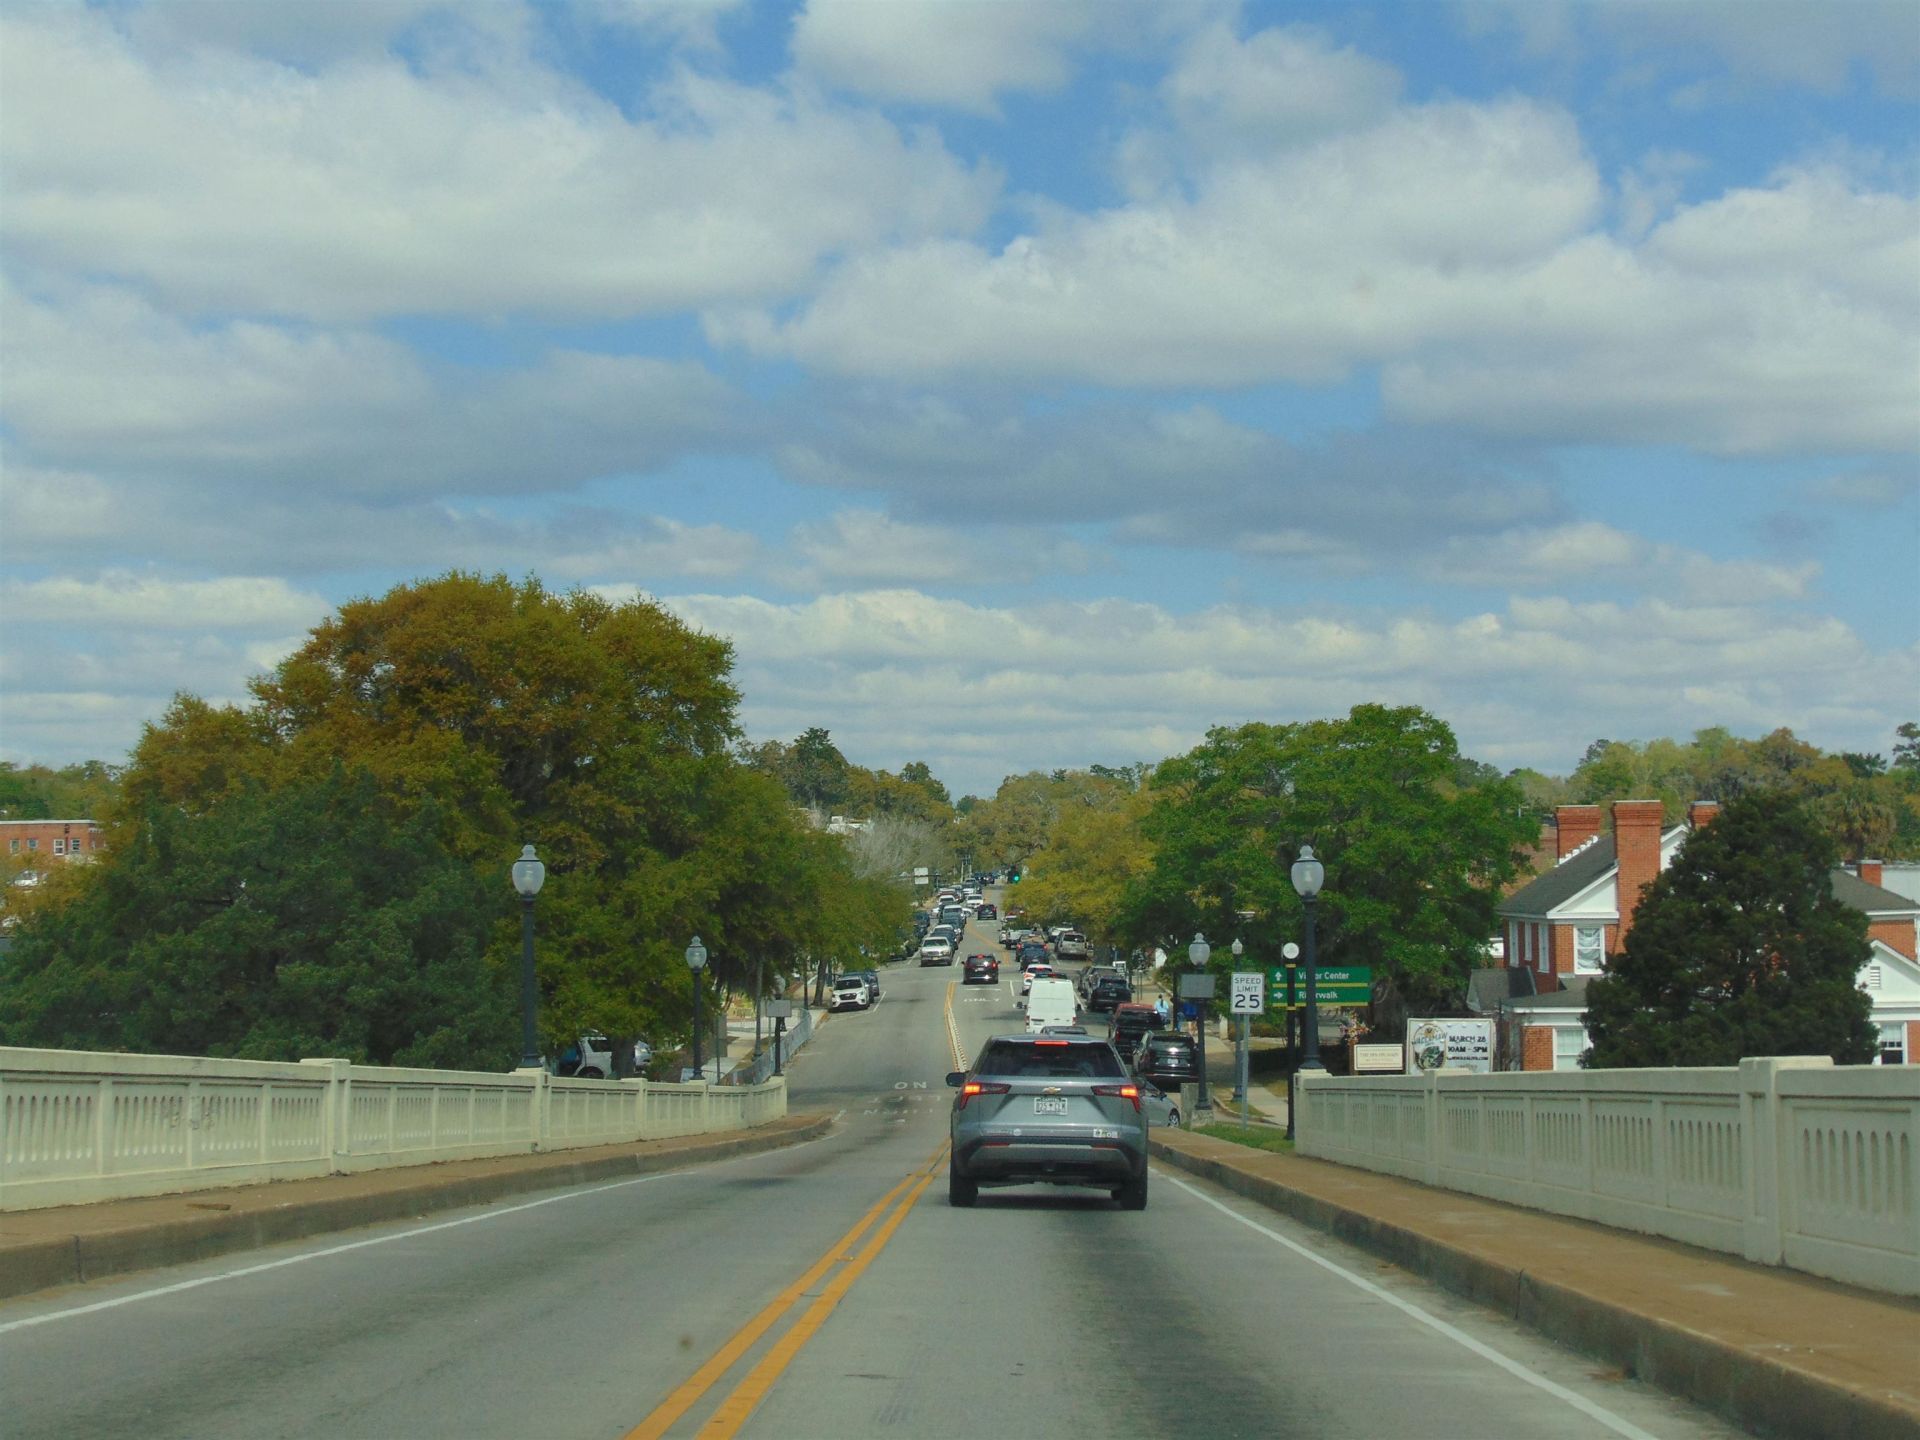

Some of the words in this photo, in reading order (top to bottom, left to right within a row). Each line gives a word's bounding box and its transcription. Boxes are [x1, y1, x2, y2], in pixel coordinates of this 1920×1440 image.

[1298, 971, 1322, 979] Vior
[1324, 971, 1350, 980] Center
[1298, 991, 1338, 999] Rirwalk
[1234, 993, 1261, 1009] 25
